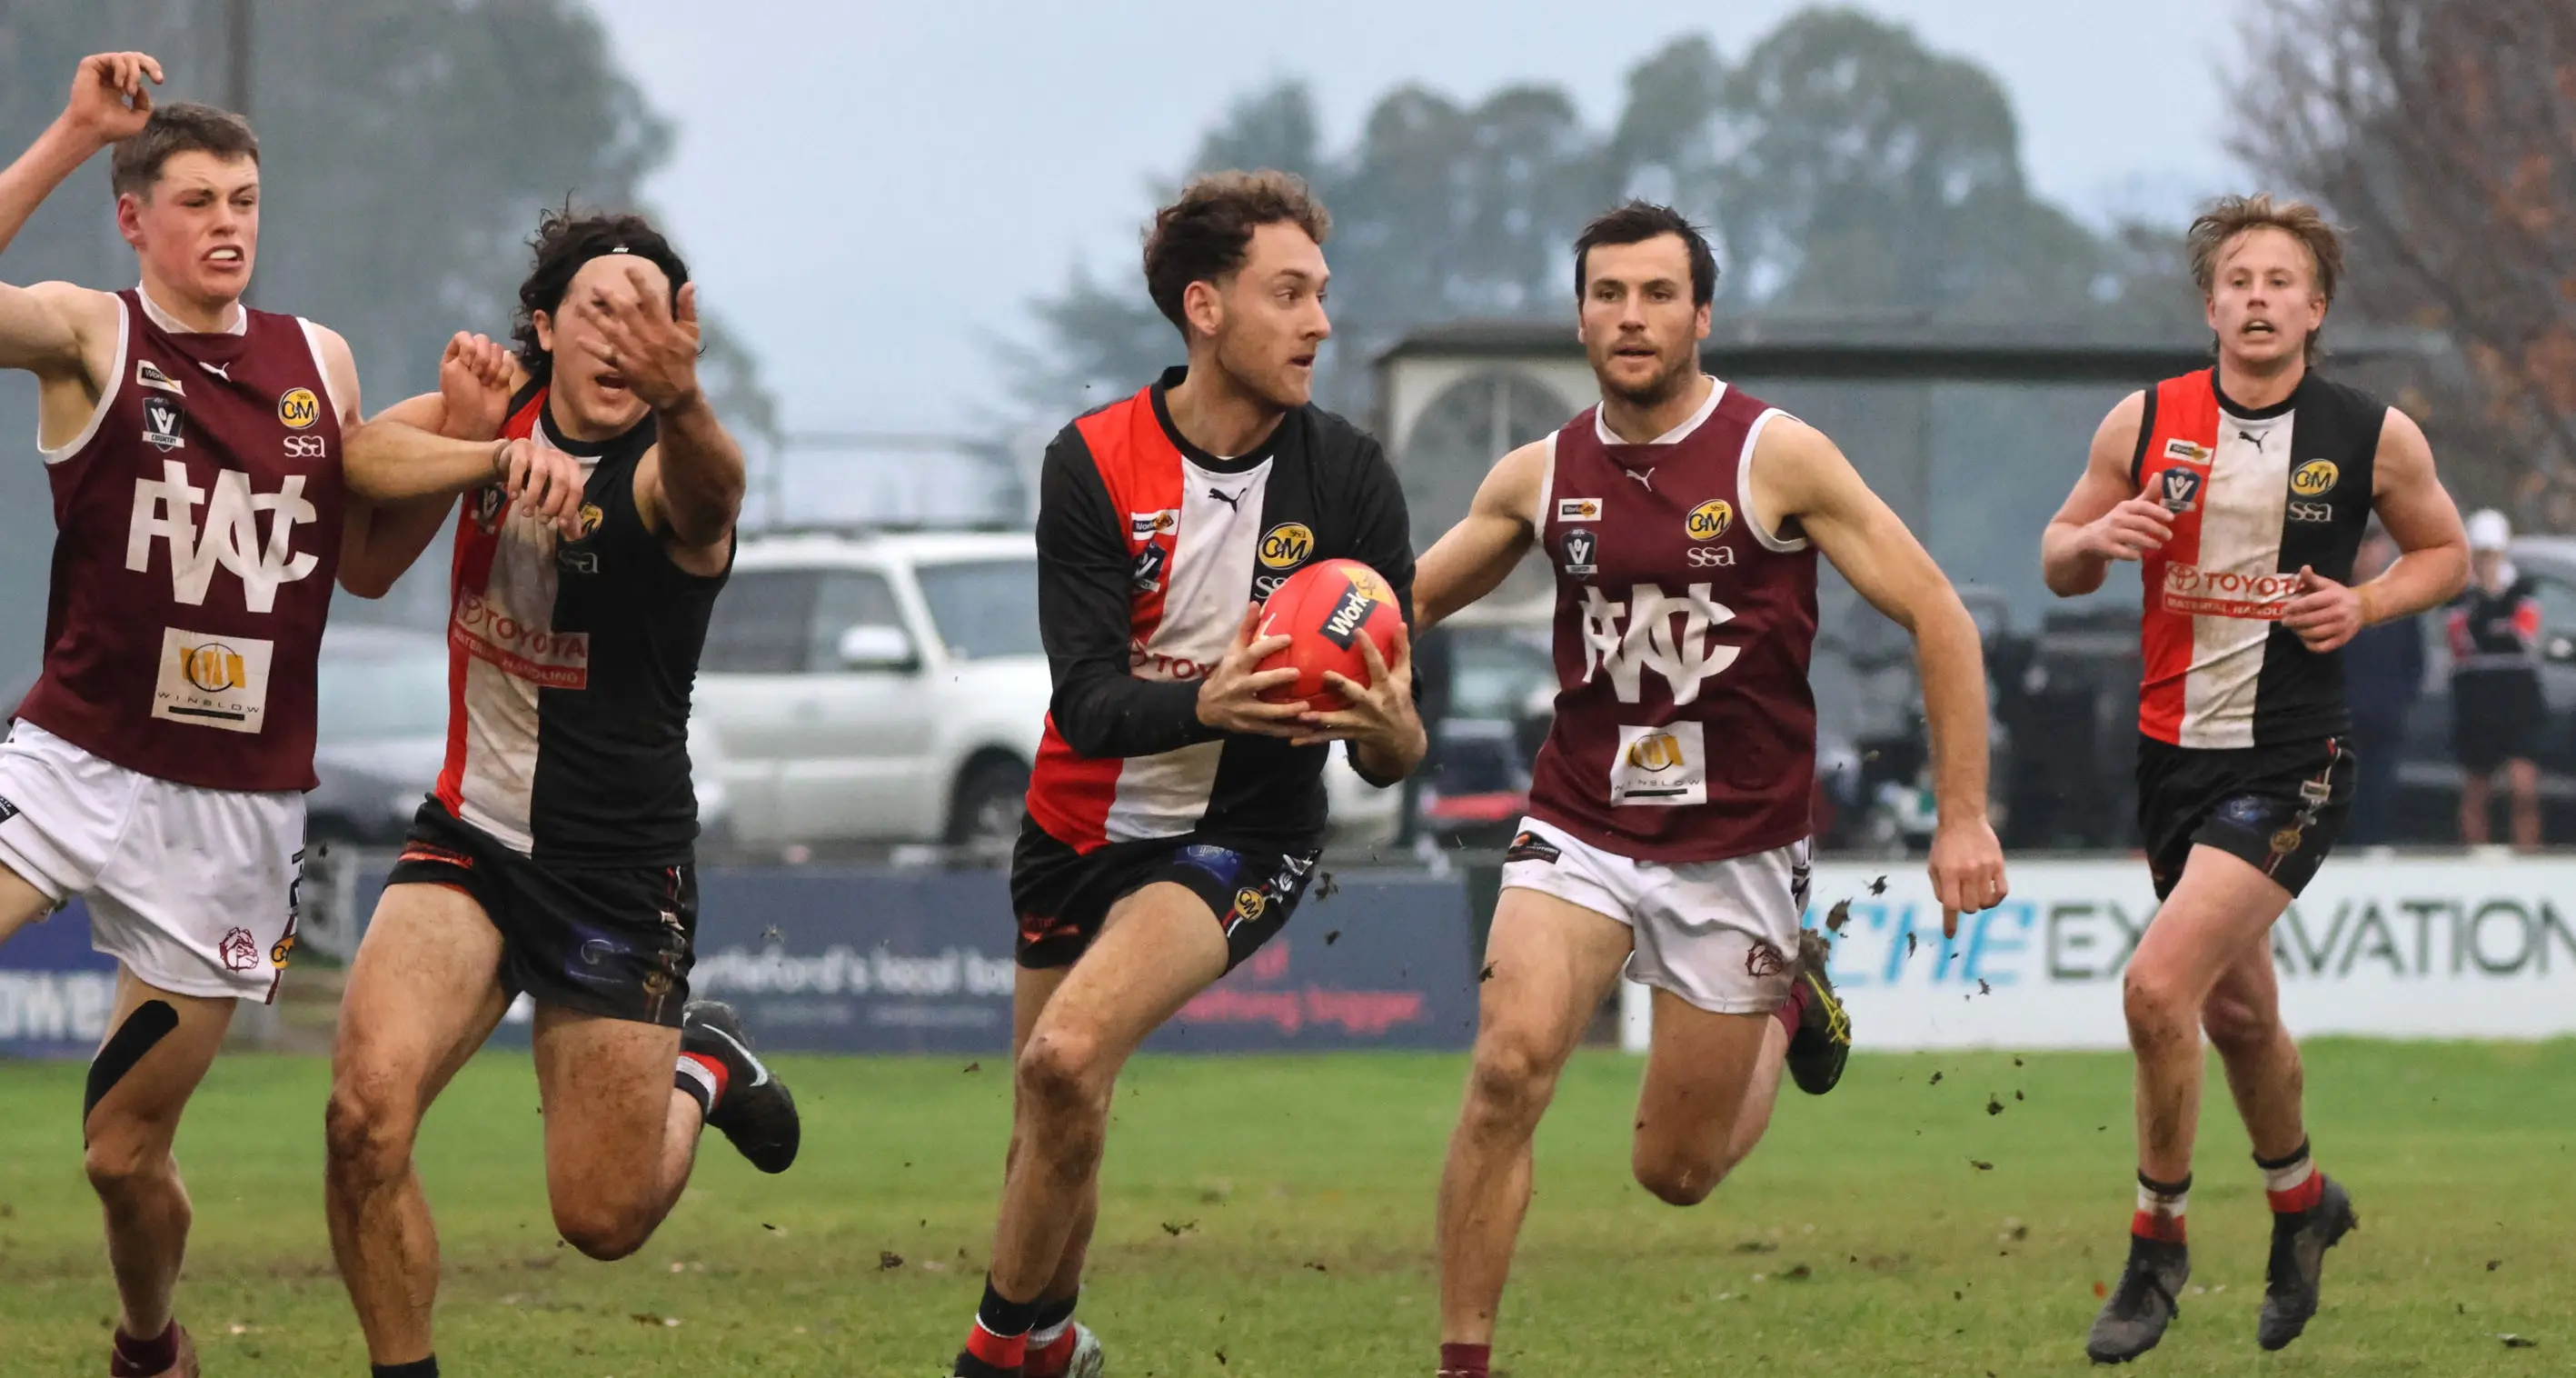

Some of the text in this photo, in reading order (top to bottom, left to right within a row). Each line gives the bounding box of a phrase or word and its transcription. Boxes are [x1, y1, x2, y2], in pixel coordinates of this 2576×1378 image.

[283, 435, 325, 457] ssa
[1686, 545, 1737, 567] ssa
[485, 608, 587, 659] TOYOTA
[1153, 652, 1224, 679] TOY
